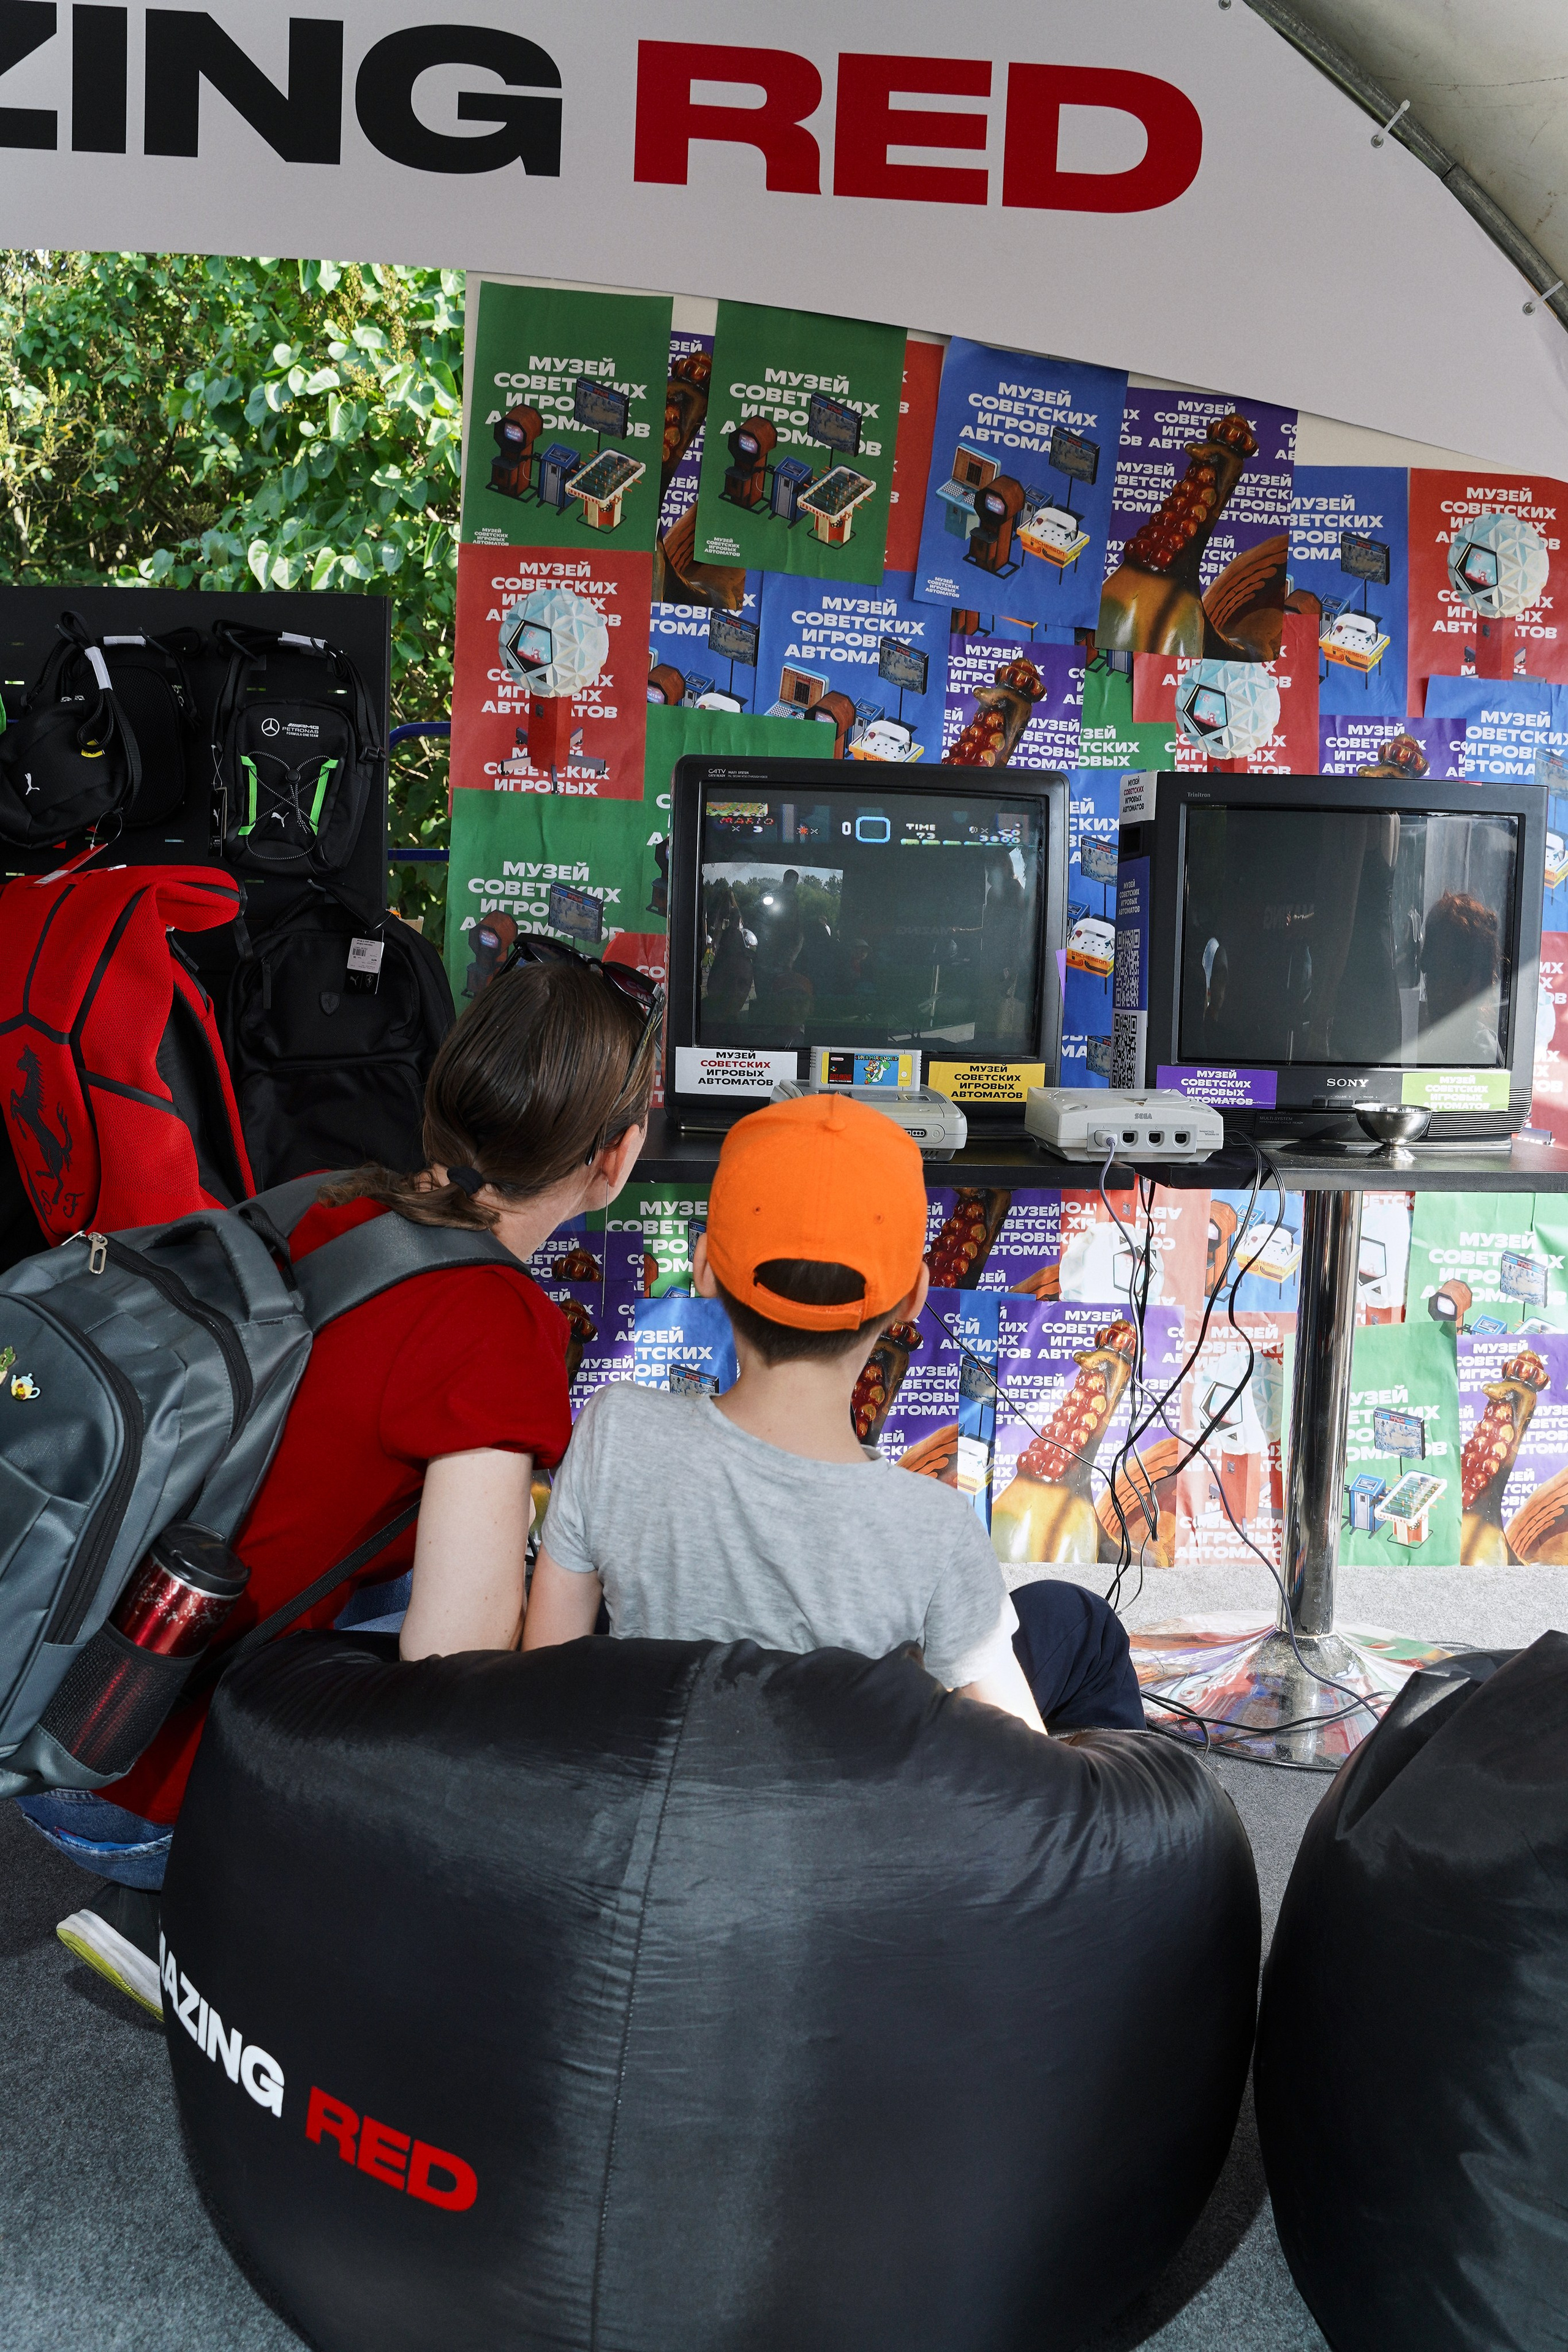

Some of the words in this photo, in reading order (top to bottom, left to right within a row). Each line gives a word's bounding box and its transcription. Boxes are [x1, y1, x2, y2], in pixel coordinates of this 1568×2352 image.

[633, 39, 1204, 214] RED
[669, 340, 702, 353] ЗЕЙ
[529, 356, 615, 377] МУЗЕЙ
[494, 372, 647, 399] СОВЕТИХ
[765, 368, 849, 394] МУЗЕЙ
[729, 383, 880, 418] СОВЕТИХ
[998, 382, 1071, 407] МУЗЕЙ
[968, 391, 1098, 429] СОВЕТСКИХ
[1178, 401, 1235, 415] МУЗЕЙ
[959, 423, 1051, 453] АВТОМА
[1163, 426, 1207, 439] ИГРО
[1117, 462, 1174, 476] МУЗЕЙ
[1467, 487, 1532, 502] МУЗЕЙ
[1441, 501, 1556, 520] СОВЕТСКИХ
[1290, 514, 1383, 527] ВЕТСКИХ
[704, 548, 741, 557] АВТОМАТОВ
[520, 561, 590, 577] МУЗЕЙ
[492, 577, 617, 595] СОВЕТСКИХ
[927, 579, 959, 590] СОВЕТСКИХ
[930, 584, 956, 593] ИГРОВЫХ
[925, 587, 960, 598] АВТОМАТОВ
[823, 597, 897, 616] МУЗЕЙ
[792, 611, 925, 636] СОВЕТСКИХ
[785, 644, 880, 665] АВТОМА
[966, 644, 1023, 660] МУЗЕЙ
[951, 669, 995, 684] ИГРО
[1481, 710, 1550, 727] МУЗЕЙ
[1348, 723, 1404, 736] МУЗЕЙ
[1079, 742, 1139, 753] ТСКИХ
[1079, 756, 1130, 766] ОВЫХ
[1335, 751, 1378, 761] ИГРО
[1465, 760, 1535, 775] ВТОМА
[1128, 778, 1139, 786] МУЗЕЙ
[1123, 785, 1144, 796] СОВЕТСКИХ
[1125, 795, 1142, 804] ИГРОВЫХ
[1123, 803, 1144, 813] АВТОМАТОВ
[503, 861, 589, 881] МУЗЕЙ
[468, 878, 621, 903] СОВЕТИХ
[1124, 879, 1135, 889] МУЗЕЙ
[1120, 888, 1139, 898] СОВЕТСКИХ
[1120, 897, 1137, 906] ИГРОВЫХ
[1119, 906, 1140, 914] АВТОМАТОВ
[716, 1050, 756, 1060] МУЗЕЙ
[701, 1059, 771, 1069] СОВЕТСКИХ
[970, 1064, 1008, 1074] МУЗЕЙ
[1197, 1070, 1236, 1079] МУЗЕЙ
[1439, 1075, 1476, 1084] МУЗЕЙ
[1181, 1079, 1251, 1088] СОВЕТСКИХ
[1327, 1079, 1369, 1088] SONY
[1187, 1088, 1244, 1096] ИГРОВЫХ
[641, 1201, 707, 1215] МУЗЕ
[606, 1219, 688, 1235] СОВЕТ
[535, 1238, 579, 1251] УЗЕЙ
[1460, 1231, 1536, 1250] МУЗЕЙ
[1065, 1309, 1122, 1322] МУЗЕЙ
[633, 1327, 683, 1343] УЗЕЙ
[1212, 1324, 1279, 1339] МУЗЕЙ
[1050, 1336, 1095, 1347] ИГРО
[1185, 1341, 1284, 1354] СОВЕТСКИ
[1473, 1340, 1528, 1354] МУЗЕЙ
[1007, 1373, 1065, 1387] МУЗЕЙ
[1460, 1368, 1502, 1379] ИГРО
[1350, 1385, 1408, 1406] УЗЕЙ
[1174, 1546, 1281, 1559] АВТОМАТО
[306, 2086, 478, 2212] RED
